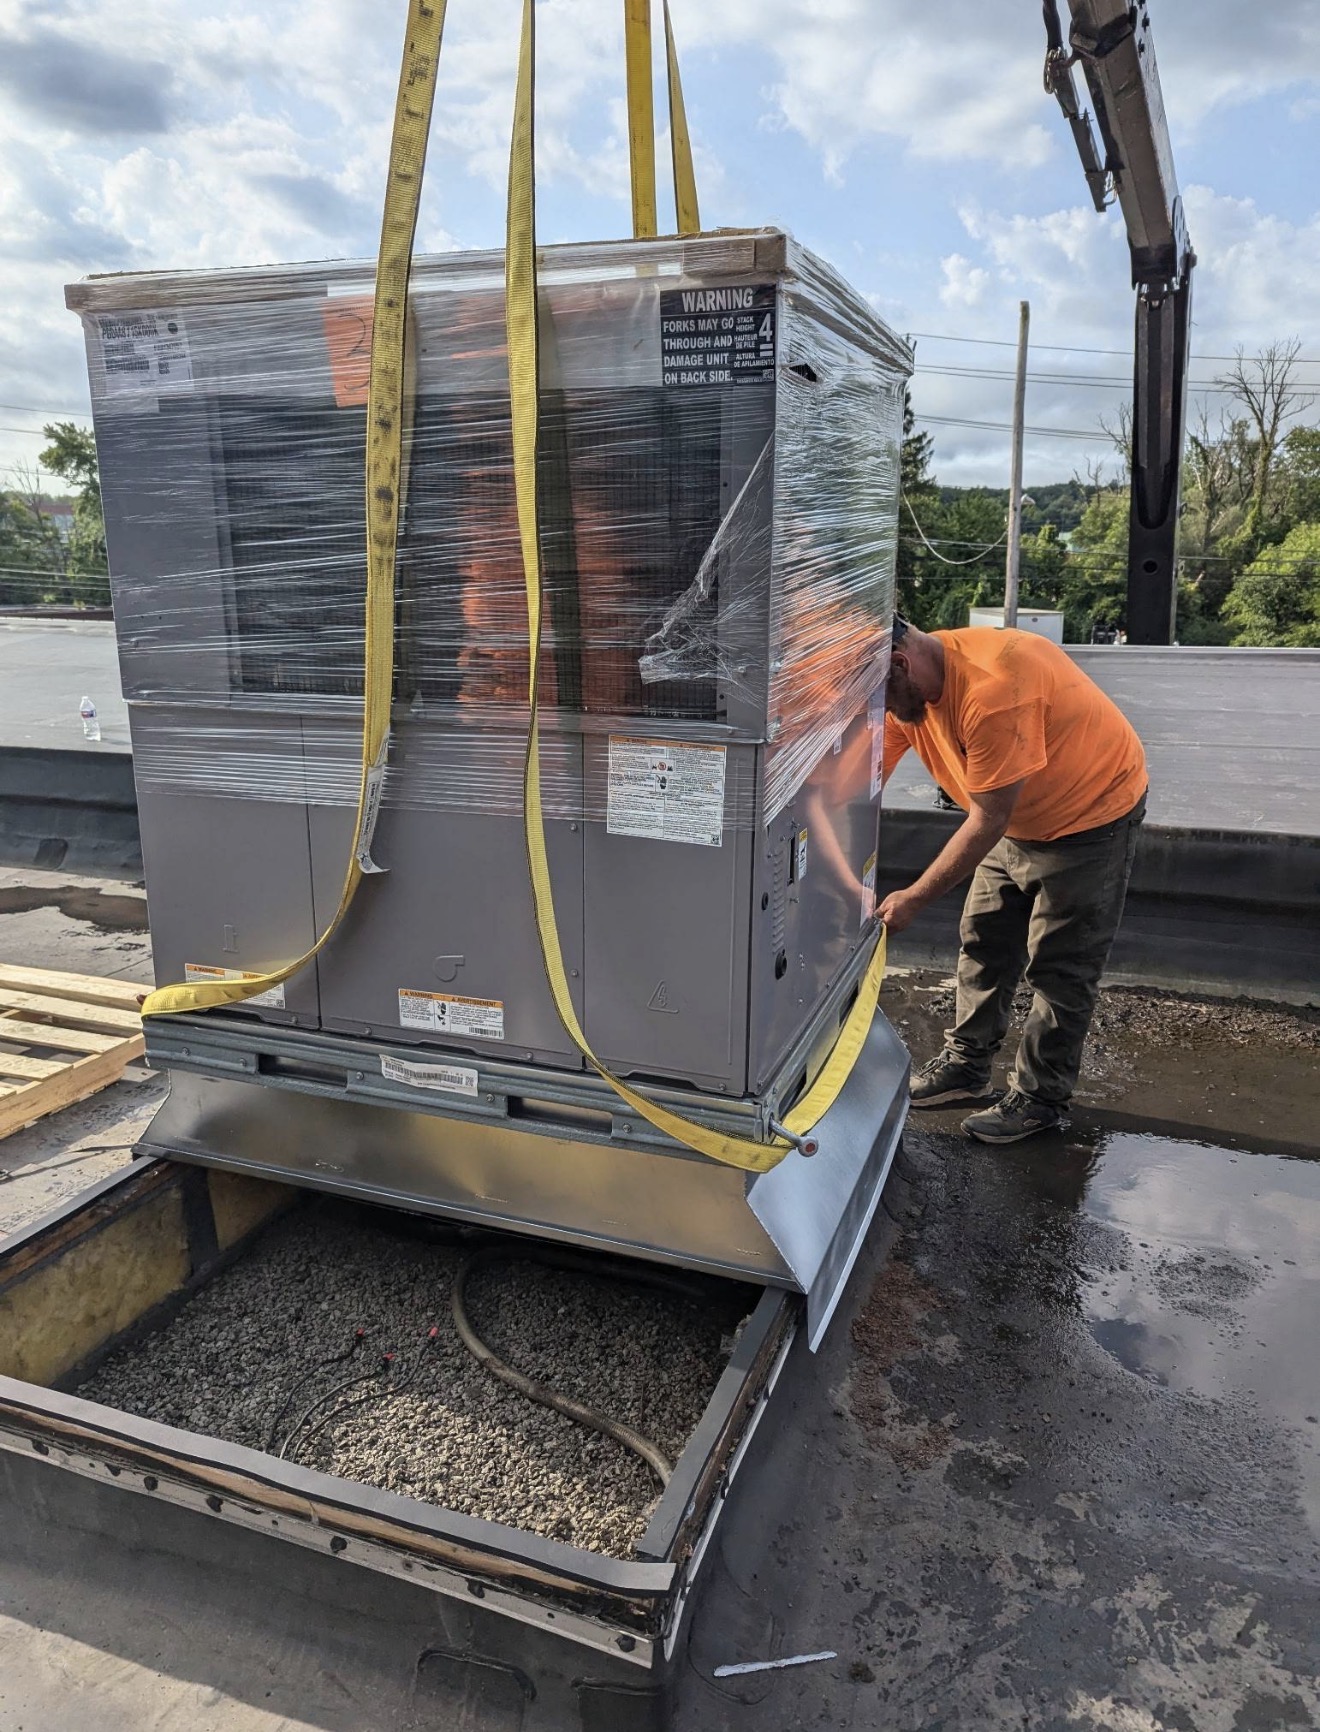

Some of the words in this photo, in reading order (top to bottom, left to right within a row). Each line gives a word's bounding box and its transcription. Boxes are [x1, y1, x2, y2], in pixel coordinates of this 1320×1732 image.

[682, 288, 753, 313] WARNING
[663, 320, 696, 332] FORKS
[698, 318, 718, 331] MAY
[721, 317, 734, 329] GO
[736, 316, 754, 324] STACK
[736, 324, 756, 332] HEIGHT
[759, 313, 773, 342] 4
[663, 337, 711, 350] THROUGH
[713, 335, 733, 347] AND
[733, 333, 758, 342] HAUTEUR
[743, 340, 756, 348] PILE
[664, 354, 703, 367] DAMAGE
[706, 353, 729, 365] UNIT
[736, 352, 756, 360] ALTURA
[741, 358, 775, 367] APILAMIENTO
[664, 373, 678, 385] ON
[680, 371, 707, 383] BACK
[709, 370, 733, 382] SIDE.
